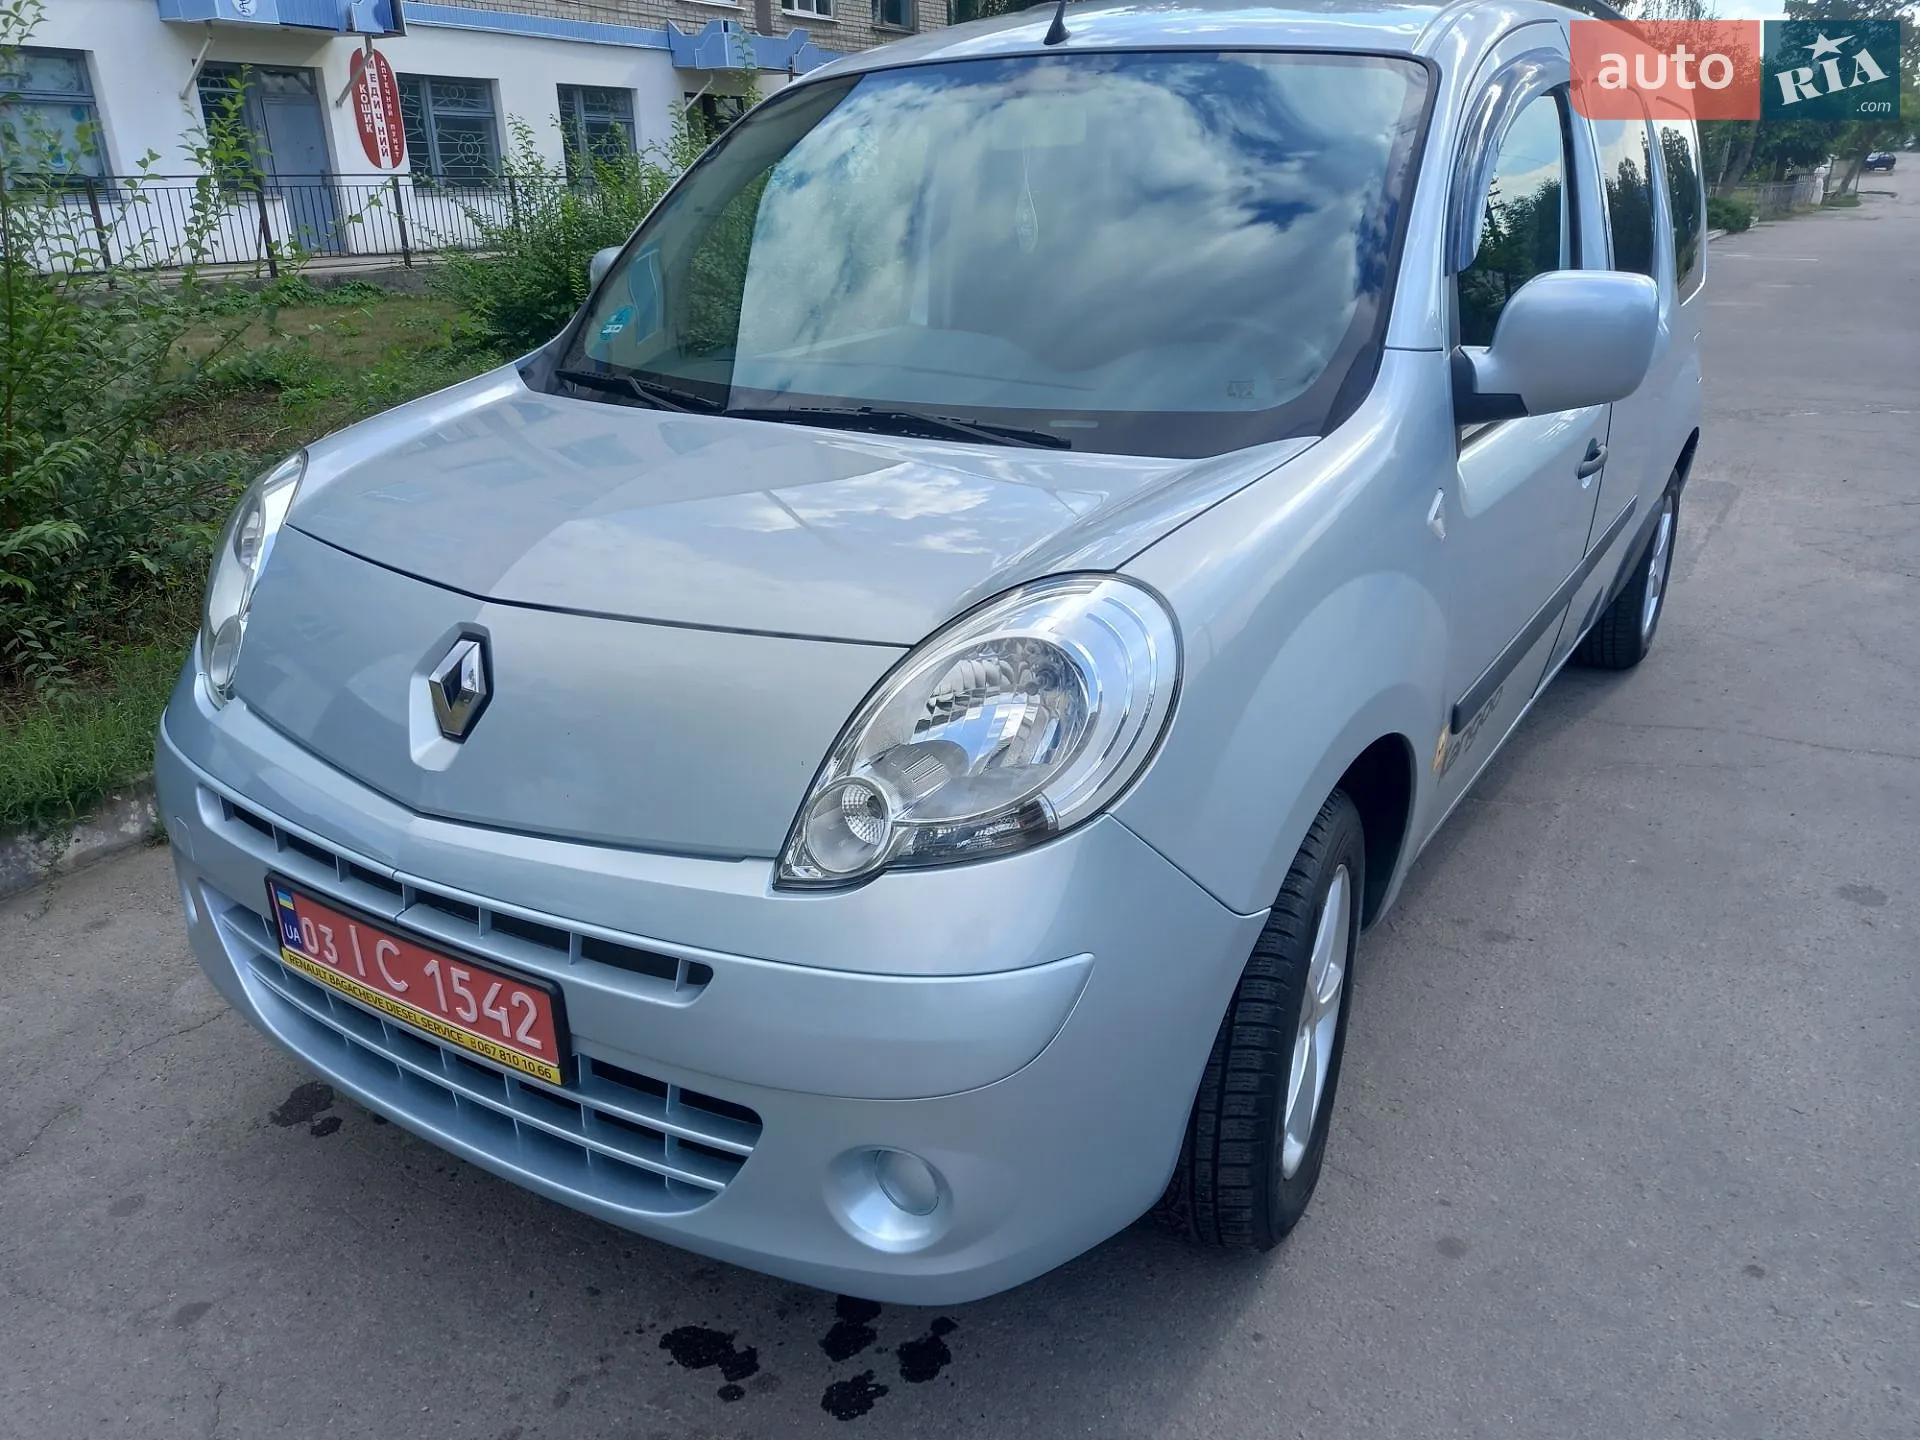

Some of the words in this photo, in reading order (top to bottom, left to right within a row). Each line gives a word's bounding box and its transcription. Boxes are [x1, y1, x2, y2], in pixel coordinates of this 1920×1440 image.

[359, 84, 373, 133] КОШИК
[367, 60, 389, 157] МЕДИЧНИЙ
[284, 923, 301, 945] UA
[288, 954, 328, 981] RENAULT
[385, 1002, 420, 1024] DIESEL
[420, 1016, 464, 1043] SERVICE
[499, 1050, 518, 1065] 810
[522, 1059, 535, 1072] 10
[538, 1066, 552, 1079] 66
[300, 917, 339, 964] 03
[424, 959, 542, 1050] 1542
